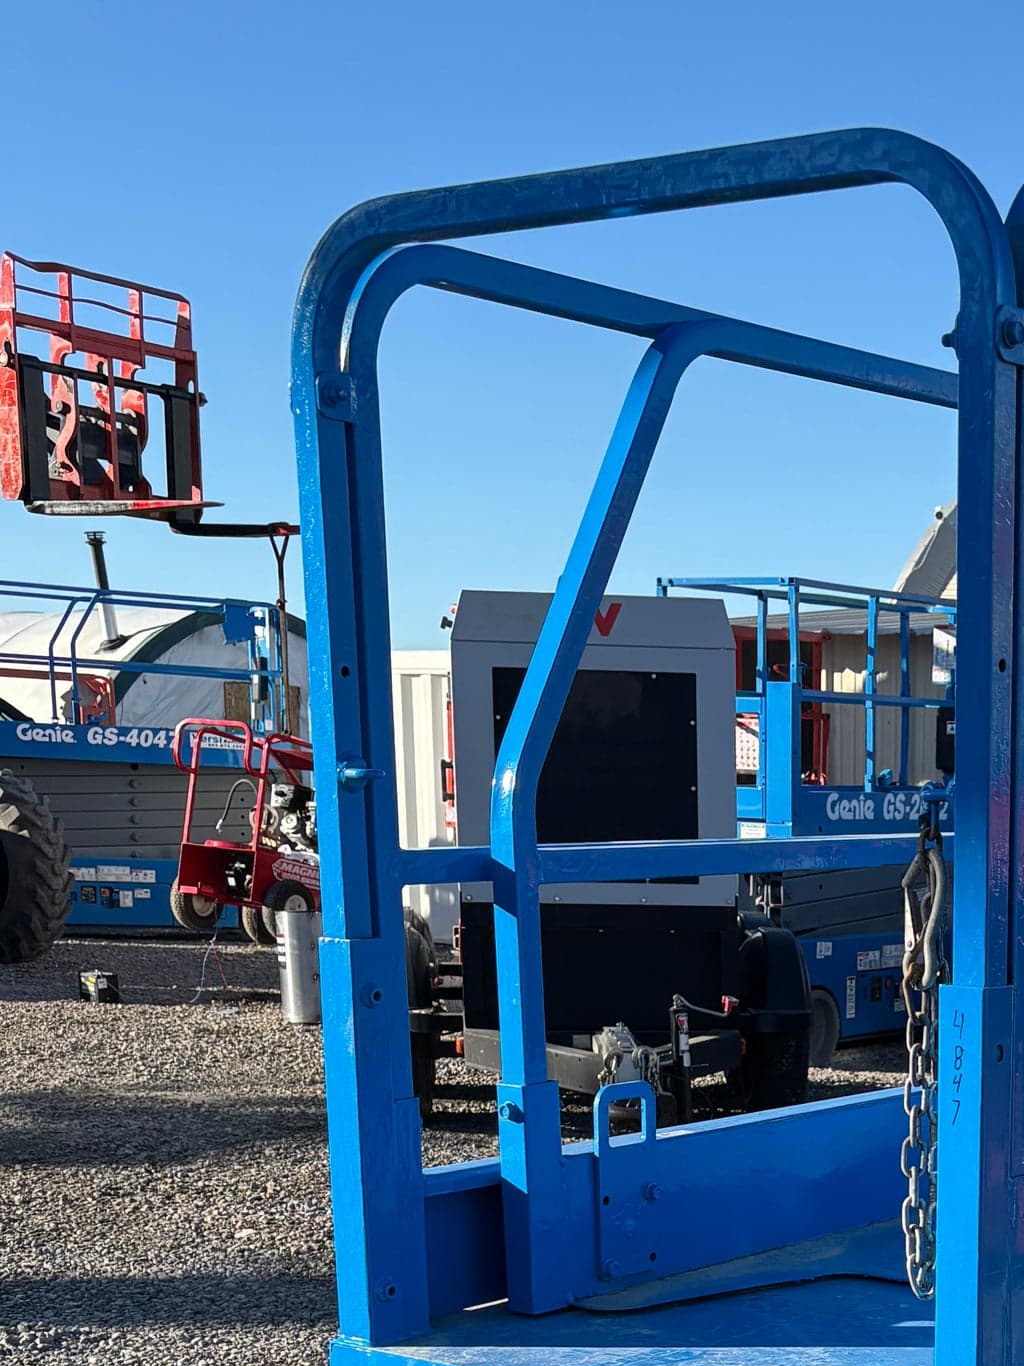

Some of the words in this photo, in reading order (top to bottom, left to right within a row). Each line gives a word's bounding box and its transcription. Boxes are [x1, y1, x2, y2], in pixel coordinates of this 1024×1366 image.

[16, 723, 75, 743] Genie
[826, 792, 874, 820] Genie
[883, 793, 948, 820] GS-22
